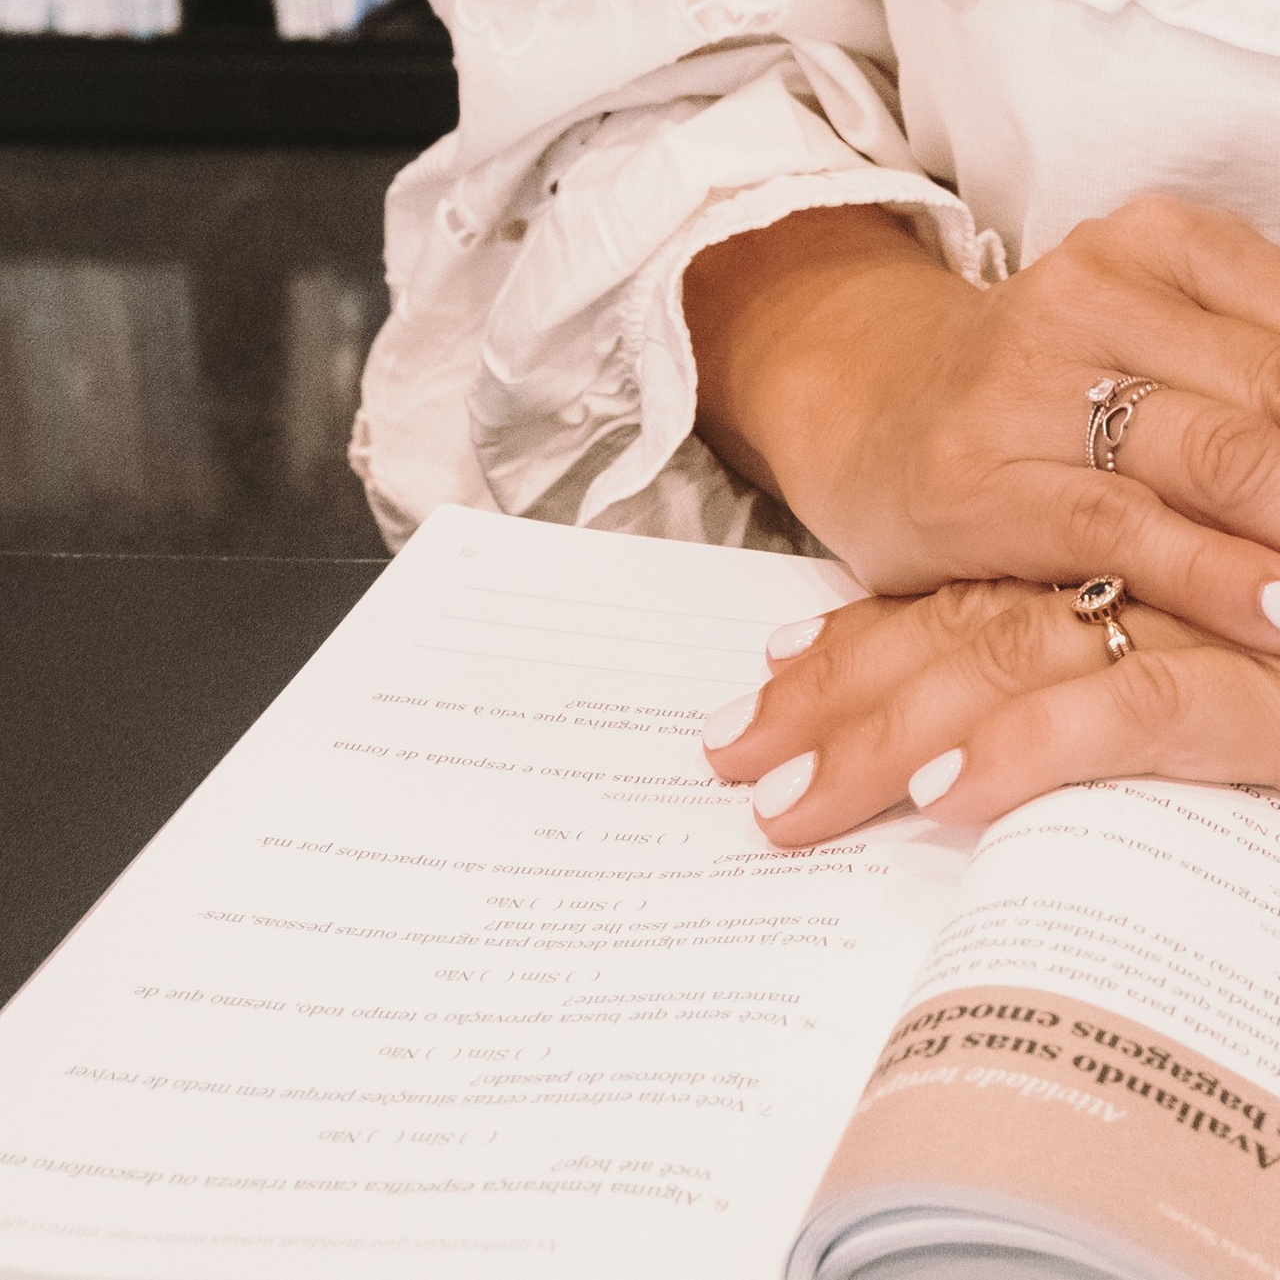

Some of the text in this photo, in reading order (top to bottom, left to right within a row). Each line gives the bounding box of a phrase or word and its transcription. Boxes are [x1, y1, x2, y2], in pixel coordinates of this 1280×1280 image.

[370, 690, 429, 706] mente
[434, 699, 468, 711] sua
[563, 697, 631, 718] acima?
[472, 704, 484, 720] à
[490, 706, 526, 721] veio
[531, 711, 567, 727] que
[572, 716, 651, 735] negativa
[331, 739, 391, 759] forma
[393, 747, 420, 765] de
[425, 752, 516, 775] responda
[521, 764, 534, 777] e
[540, 765, 605, 785] abaixo
[612, 773, 712, 791] perguntas
[600, 790, 730, 808] sentimentos
[1124, 788, 1170, 810] pesa
[1038, 825, 1089, 837] Caso
[1176, 806, 1230, 838] ainda
[1232, 811, 1269, 836] Não
[254, 834, 293, 851] má-
[533, 826, 652, 847] Sim Não
[296, 839, 332, 858] por
[711, 842, 867, 865] goas passadas?
[1099, 830, 1173, 863] abaixo.
[335, 845, 447, 873] impactados
[452, 859, 487, 876] são
[491, 862, 653, 883] relacionamentos
[658, 870, 702, 883] seus
[708, 865, 745, 881] que
[751, 865, 801, 877] sente
[805, 862, 853, 876] Você
[485, 895, 608, 913] Sim Não
[1033, 898, 1128, 926] primeiro
[197, 908, 245, 927] mes-
[251, 913, 332, 938] pessoas,
[483, 915, 840, 937] mo sabendo que isso lhe faria mal?
[333, 923, 397, 942] outras
[1133, 923, 1145, 934] o
[400, 930, 480, 948] agradar
[484, 935, 531, 948] para
[533, 938, 607, 952] decisão
[611, 934, 687, 950] alguma
[693, 934, 755, 948] tomou
[759, 931, 779, 947] já
[781, 932, 828, 947] Você
[1035, 918, 1161, 964] sinceridade
[1149, 933, 1187, 954] dar
[1046, 943, 1106, 964] estar
[988, 958, 1036, 971] você
[1167, 960, 1211, 988] com
[434, 968, 561, 985] Sim Não
[1044, 963, 1119, 991] ajudar
[1112, 961, 1166, 988] pode
[132, 985, 789, 1027] Você sente que busca aprovação o tempo todo, mesmo que de
[562, 991, 801, 1008] maneira inconsciente?
[1126, 988, 1177, 1017] para
[1172, 987, 1210, 1010] que
[1183, 1015, 1250, 1056] criada
[378, 1045, 509, 1062] Sim Não
[960, 1031, 1063, 1061] suas
[469, 1070, 760, 1091] algo doloroso do passado?
[1071, 1020, 1266, 1130] bagagens
[63, 1064, 745, 1113] Você evita enfrentar certas situações porque tem medo de reviver
[318, 1129, 455, 1146] Sim Não
[551, 1154, 712, 1180] você até hoje?
[32, 1156, 701, 1206] Alguma lembrança específica causa tristeza ou desconforto
